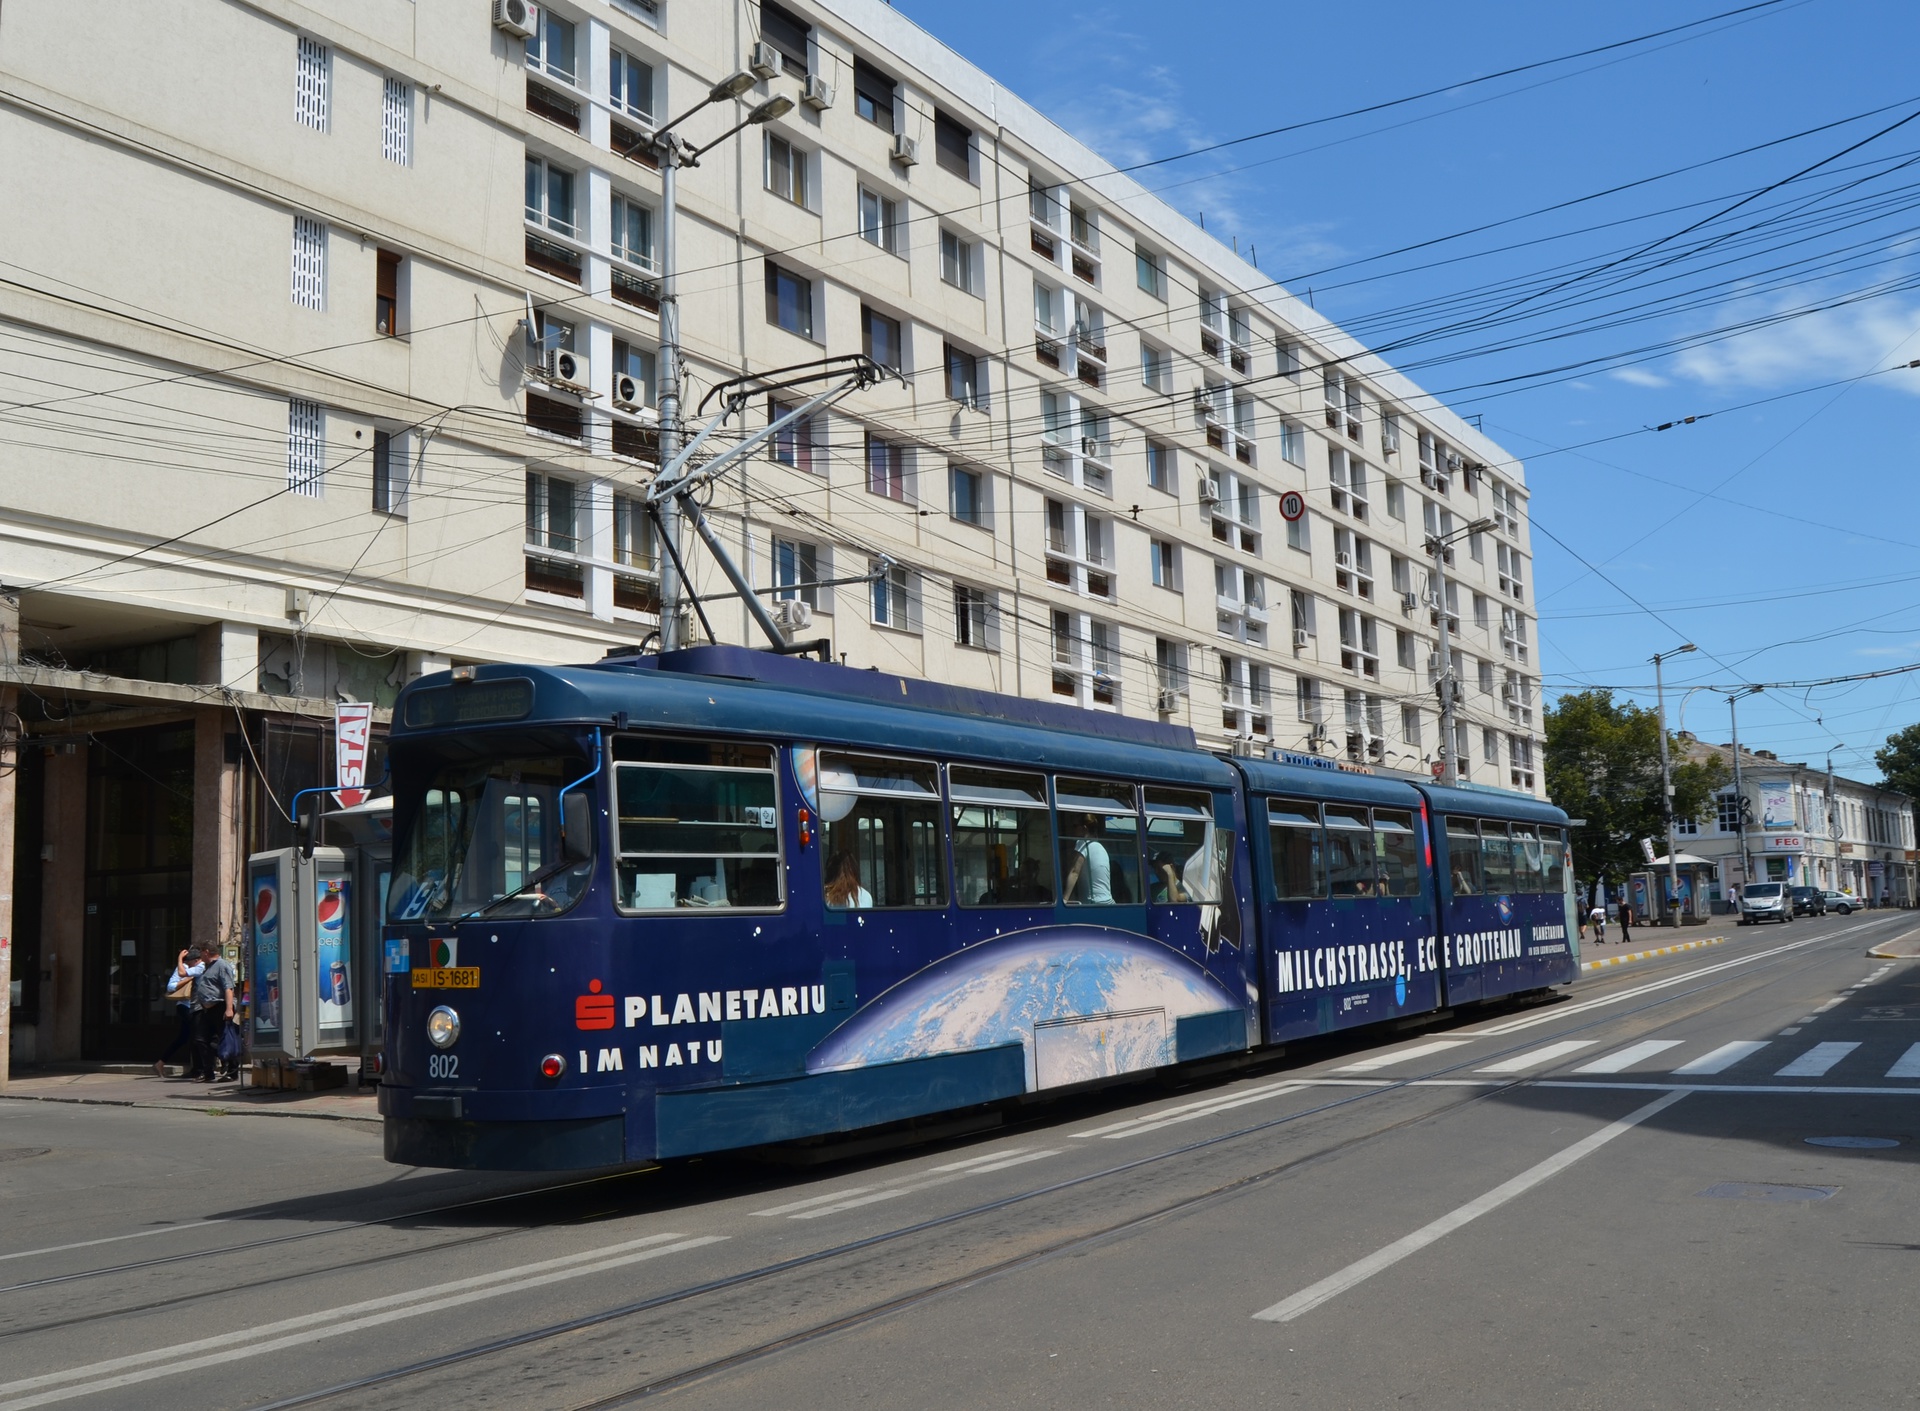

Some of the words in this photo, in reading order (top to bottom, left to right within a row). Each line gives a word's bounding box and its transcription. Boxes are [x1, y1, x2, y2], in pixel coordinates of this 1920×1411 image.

[1286, 498, 1297, 514] 10
[340, 706, 368, 787] STAI
[1775, 838, 1799, 846] FEG
[1532, 925, 1565, 941] PLANETARIUM
[1278, 940, 1412, 993] MILCHSTRASSE,
[1456, 928, 1522, 967] GROTTENAU
[433, 970, 475, 986] IS-1681
[624, 984, 826, 1028] PLANETARIU
[429, 1054, 459, 1078] 802
[579, 1047, 624, 1074] IM
[639, 1039, 723, 1069] NATU
